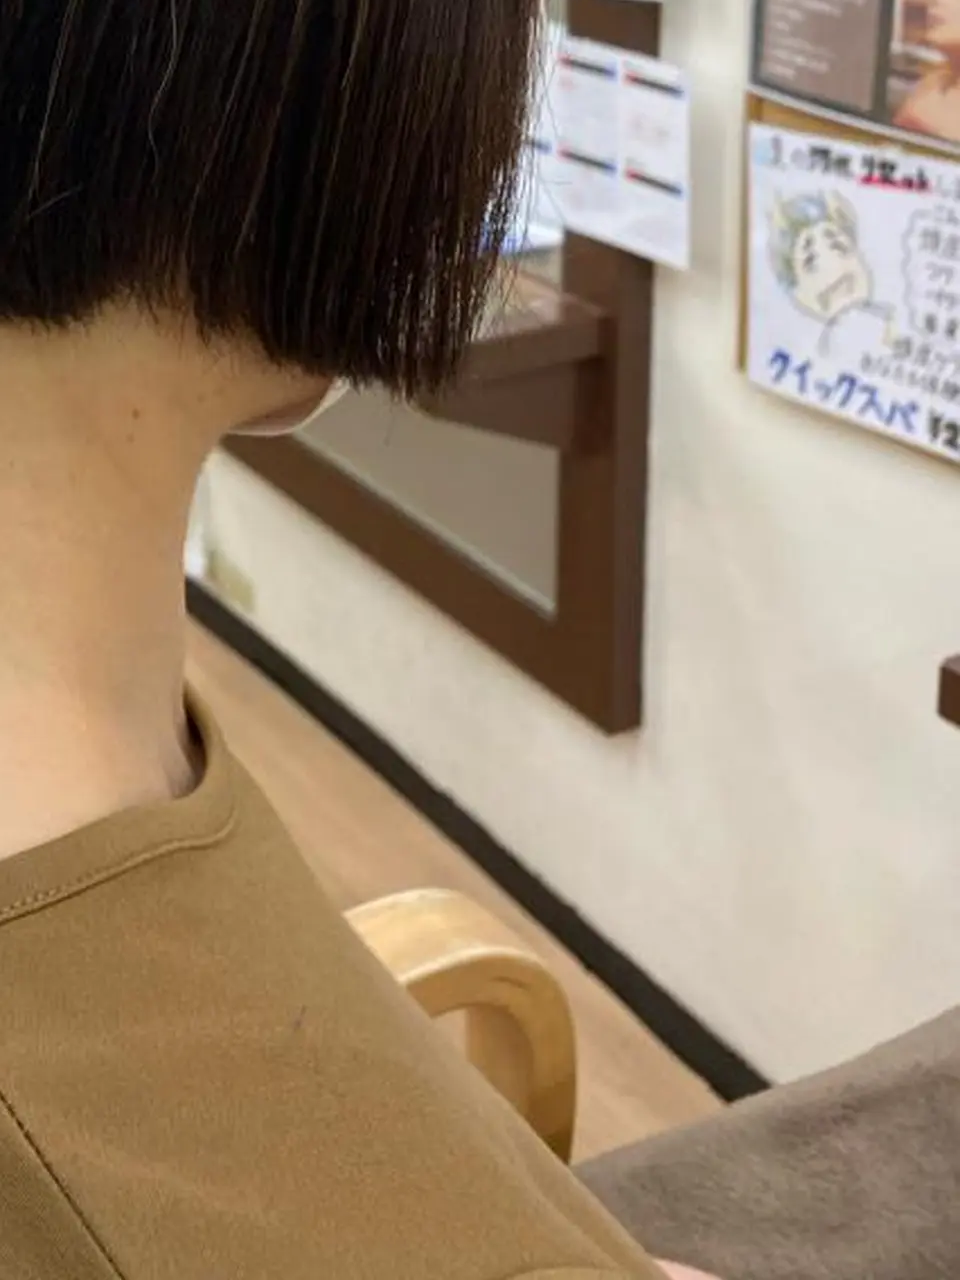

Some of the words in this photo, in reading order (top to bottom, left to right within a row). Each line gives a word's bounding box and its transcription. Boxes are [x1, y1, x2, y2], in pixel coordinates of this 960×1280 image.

[769, 349, 919, 433] クイックスパ
